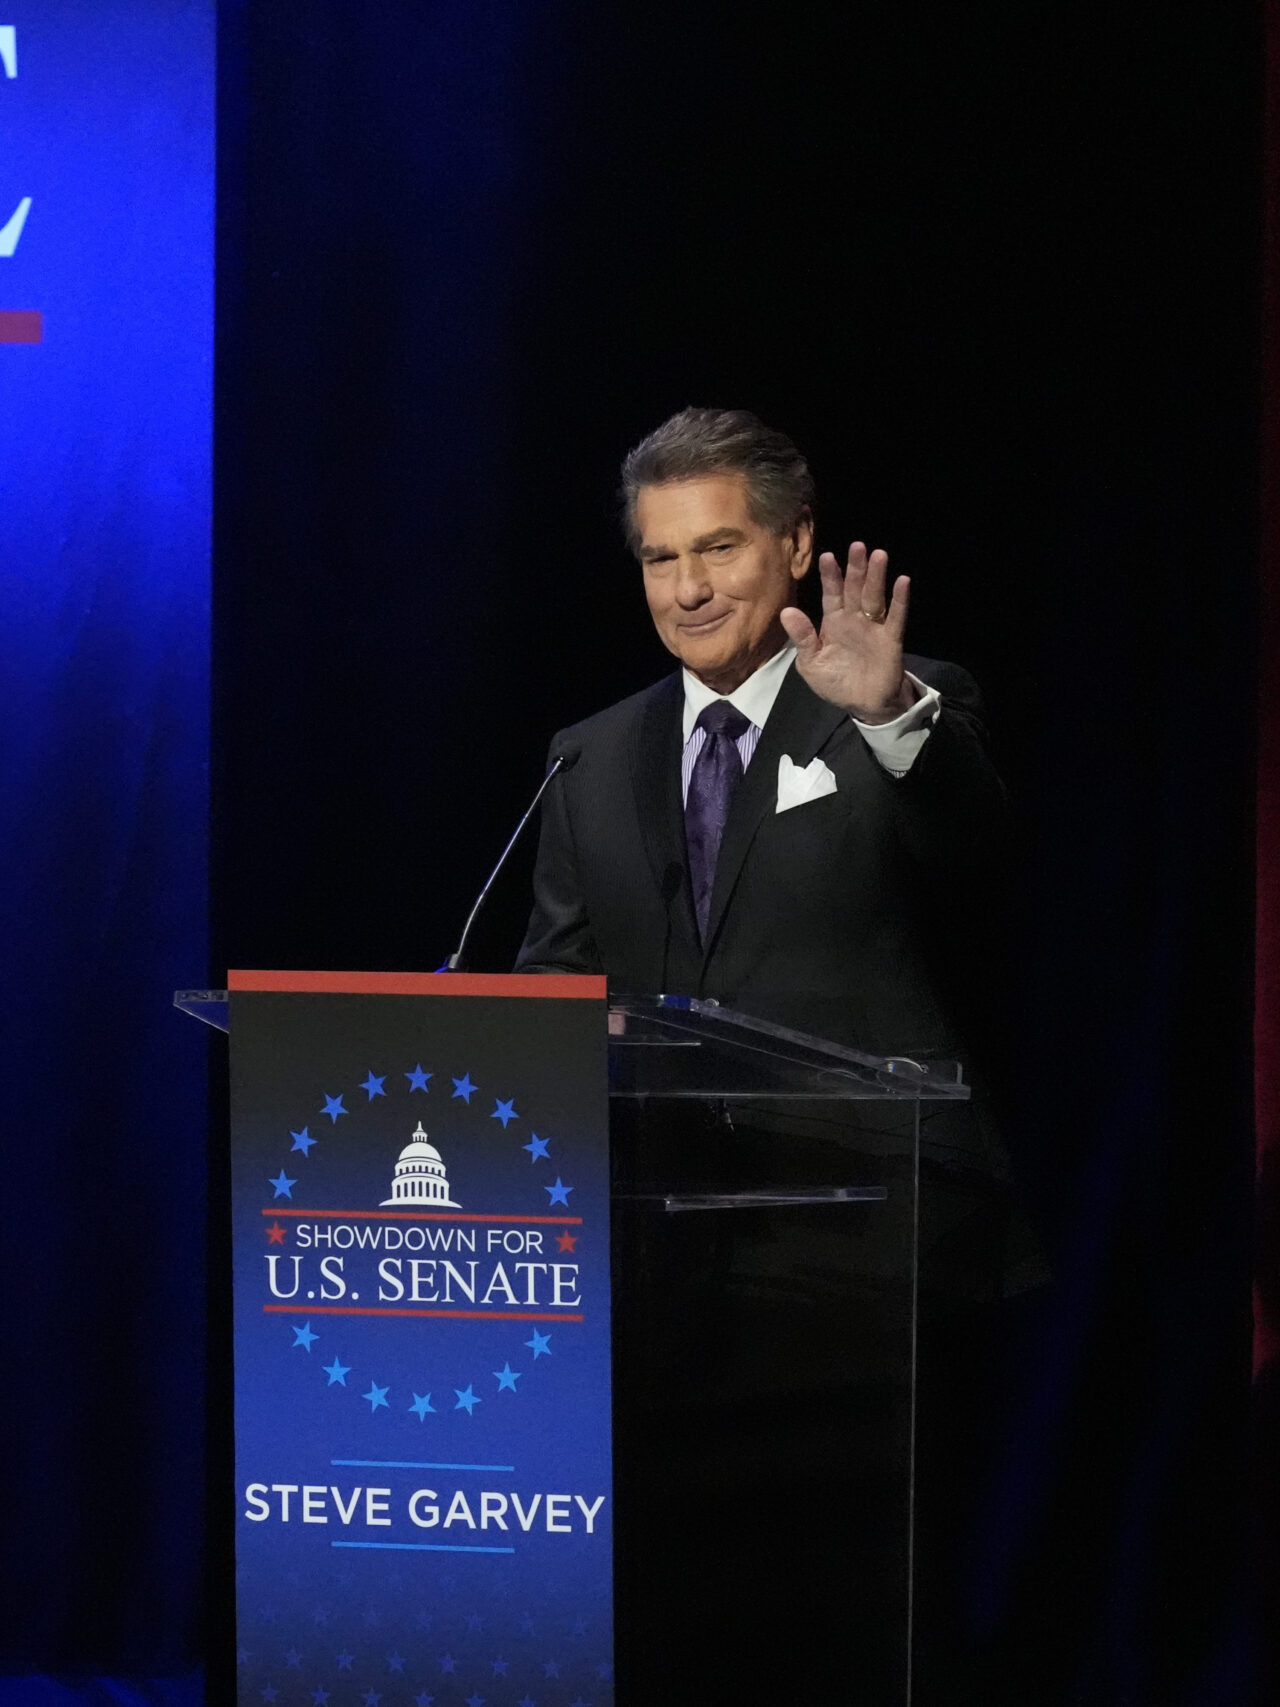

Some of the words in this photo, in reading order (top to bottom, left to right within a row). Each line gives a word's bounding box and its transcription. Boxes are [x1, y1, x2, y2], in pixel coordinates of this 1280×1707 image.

[295, 1223, 476, 1252] SHOWDOWN
[487, 1230, 544, 1255] FOR
[264, 1255, 360, 1301] U.S.
[378, 1260, 582, 1307] SENATE
[244, 1482, 391, 1526] STEVE
[408, 1488, 606, 1534] GARVEY
